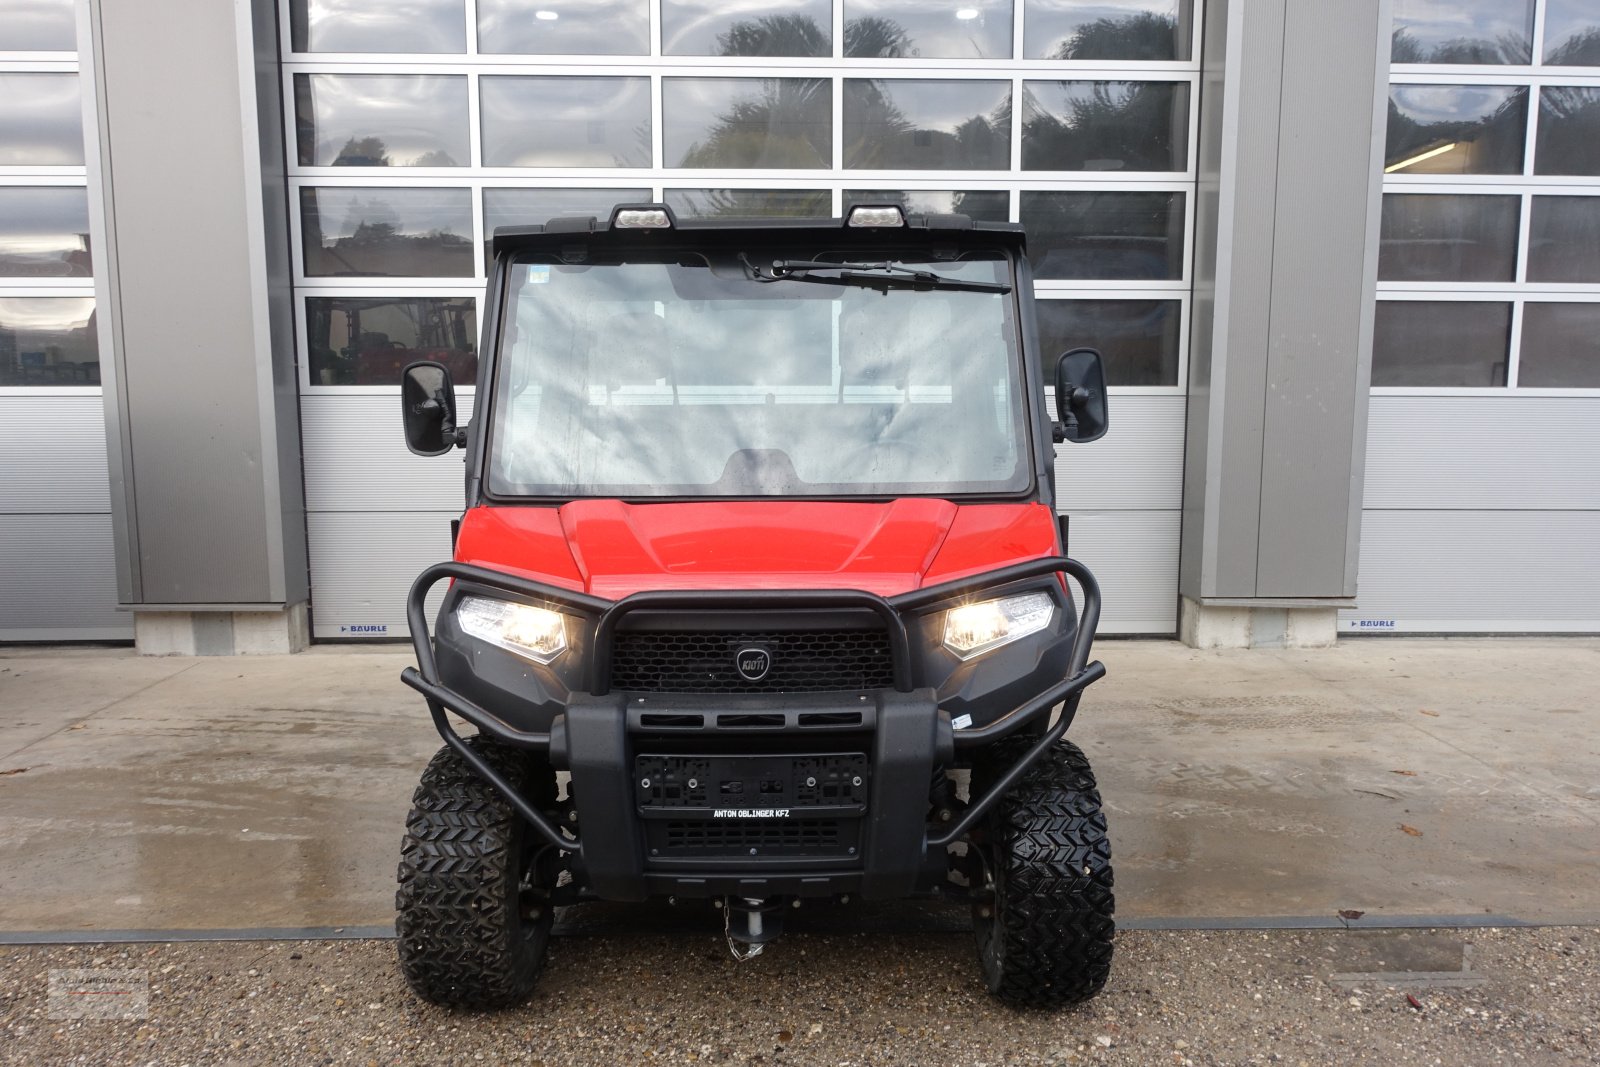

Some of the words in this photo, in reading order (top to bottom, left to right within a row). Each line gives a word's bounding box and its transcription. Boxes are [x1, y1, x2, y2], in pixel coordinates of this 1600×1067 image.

[742, 660, 765, 670] KIOTI
[713, 809, 737, 818] ANTON
[738, 809, 774, 818] OBLINGER
[775, 809, 790, 817] KFZ
